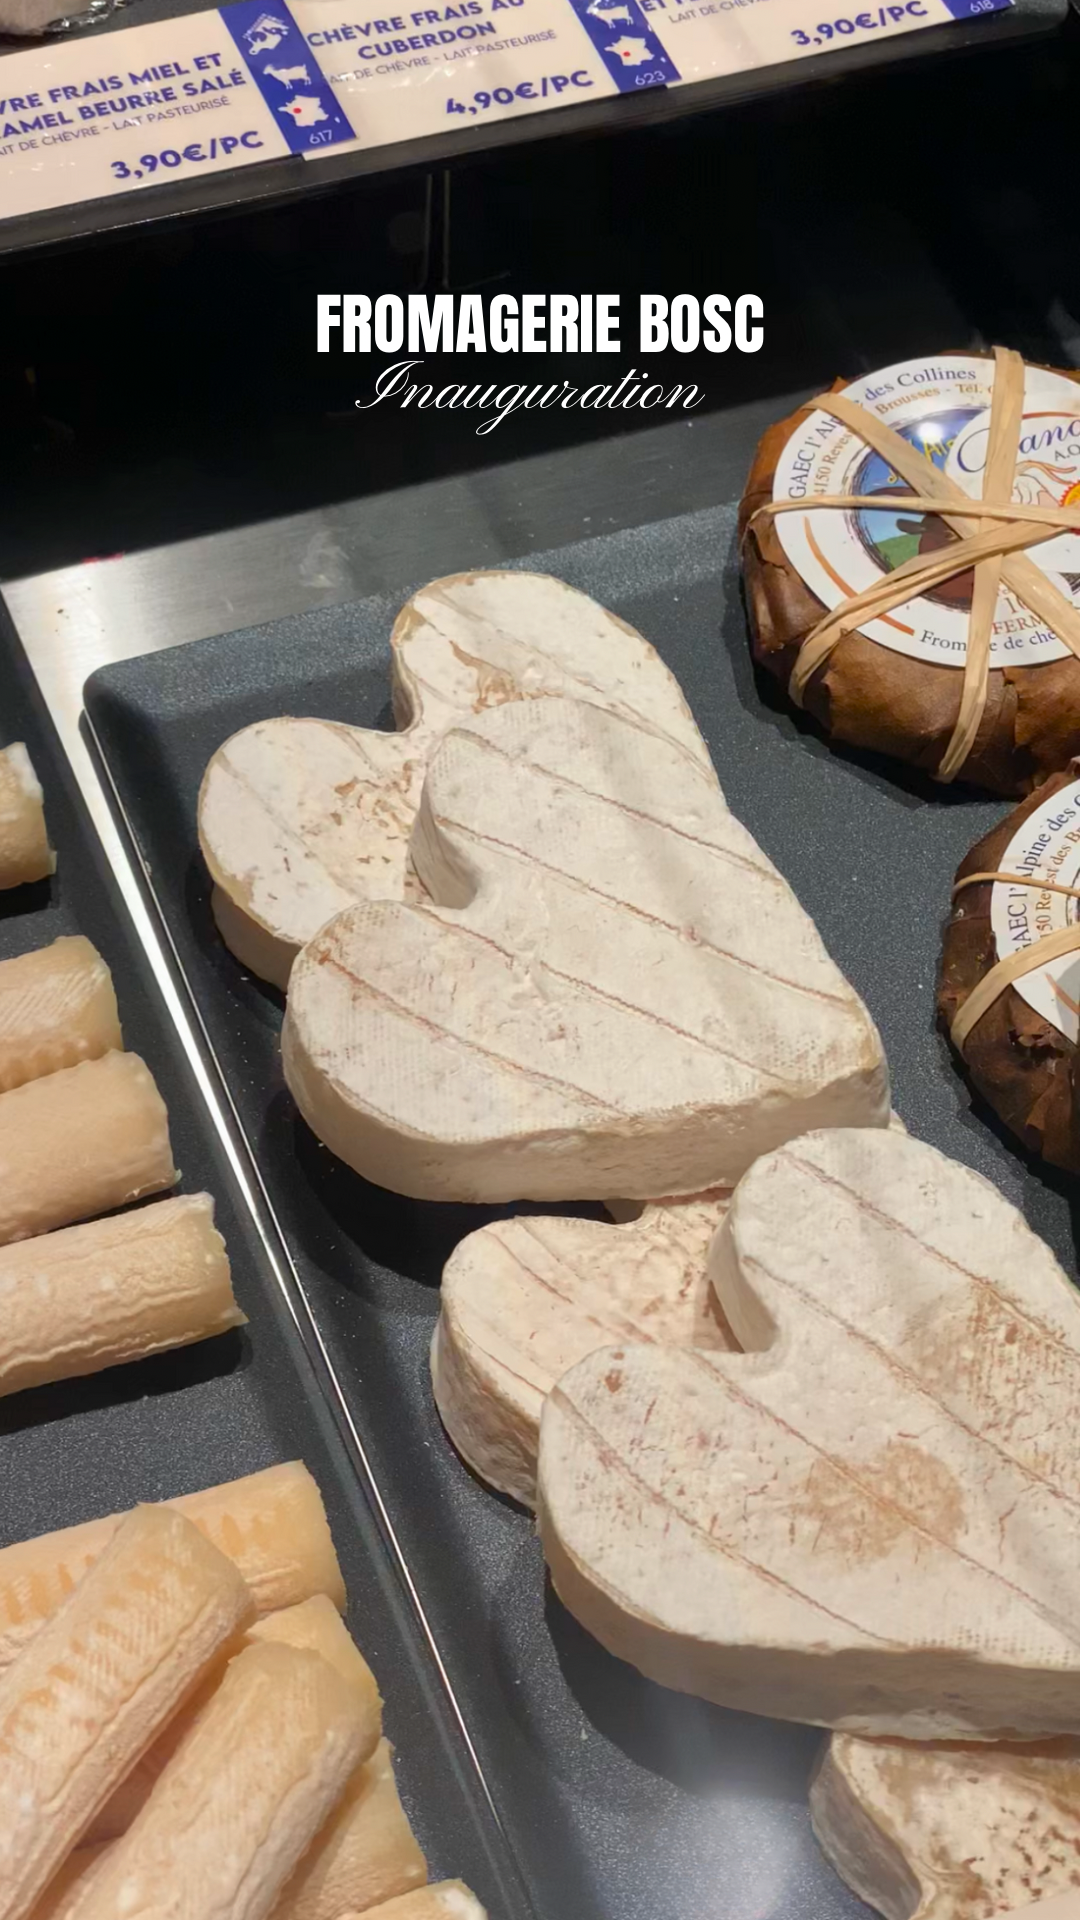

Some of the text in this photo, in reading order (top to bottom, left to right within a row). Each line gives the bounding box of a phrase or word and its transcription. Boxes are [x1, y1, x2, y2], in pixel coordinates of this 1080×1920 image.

[307, 16, 406, 46] CHÈVRE
[410, 1, 483, 27] FRAIS
[668, 10, 697, 24] LAIT
[699, 4, 719, 16] DE
[790, 1, 928, 45] 3,90€/PC
[970, 0, 994, 13] 618
[353, 67, 373, 80] DE
[443, 46, 473, 61] LAIT
[475, 29, 557, 54] PASTEURISÉ
[358, 21, 496, 59] CUBERDON
[47, 75, 123, 103] FRAIS
[128, 61, 190, 86] MIEL
[193, 53, 221, 71] ET
[446, 70, 594, 115] 4,90€/PC
[635, 70, 666, 86] 623
[0, 68, 246, 139] AMEL BEURRE SALÉ
[18, 139, 39, 151] DE
[112, 115, 142, 131] LAIT
[147, 95, 231, 122] PASTEURISÉ
[110, 131, 264, 179] 3,90€/PC
[309, 129, 333, 145] 617
[788, 449, 816, 499] GAEC
[864, 383, 895, 401] des
[897, 367, 976, 387] Collines
[822, 432, 853, 465] Reves
[875, 387, 940, 414] Brousses
[920, 630, 997, 652] Frome
[1003, 636, 1024, 650] de
[1047, 808, 1076, 831] des
[1050, 844, 1071, 866] des
